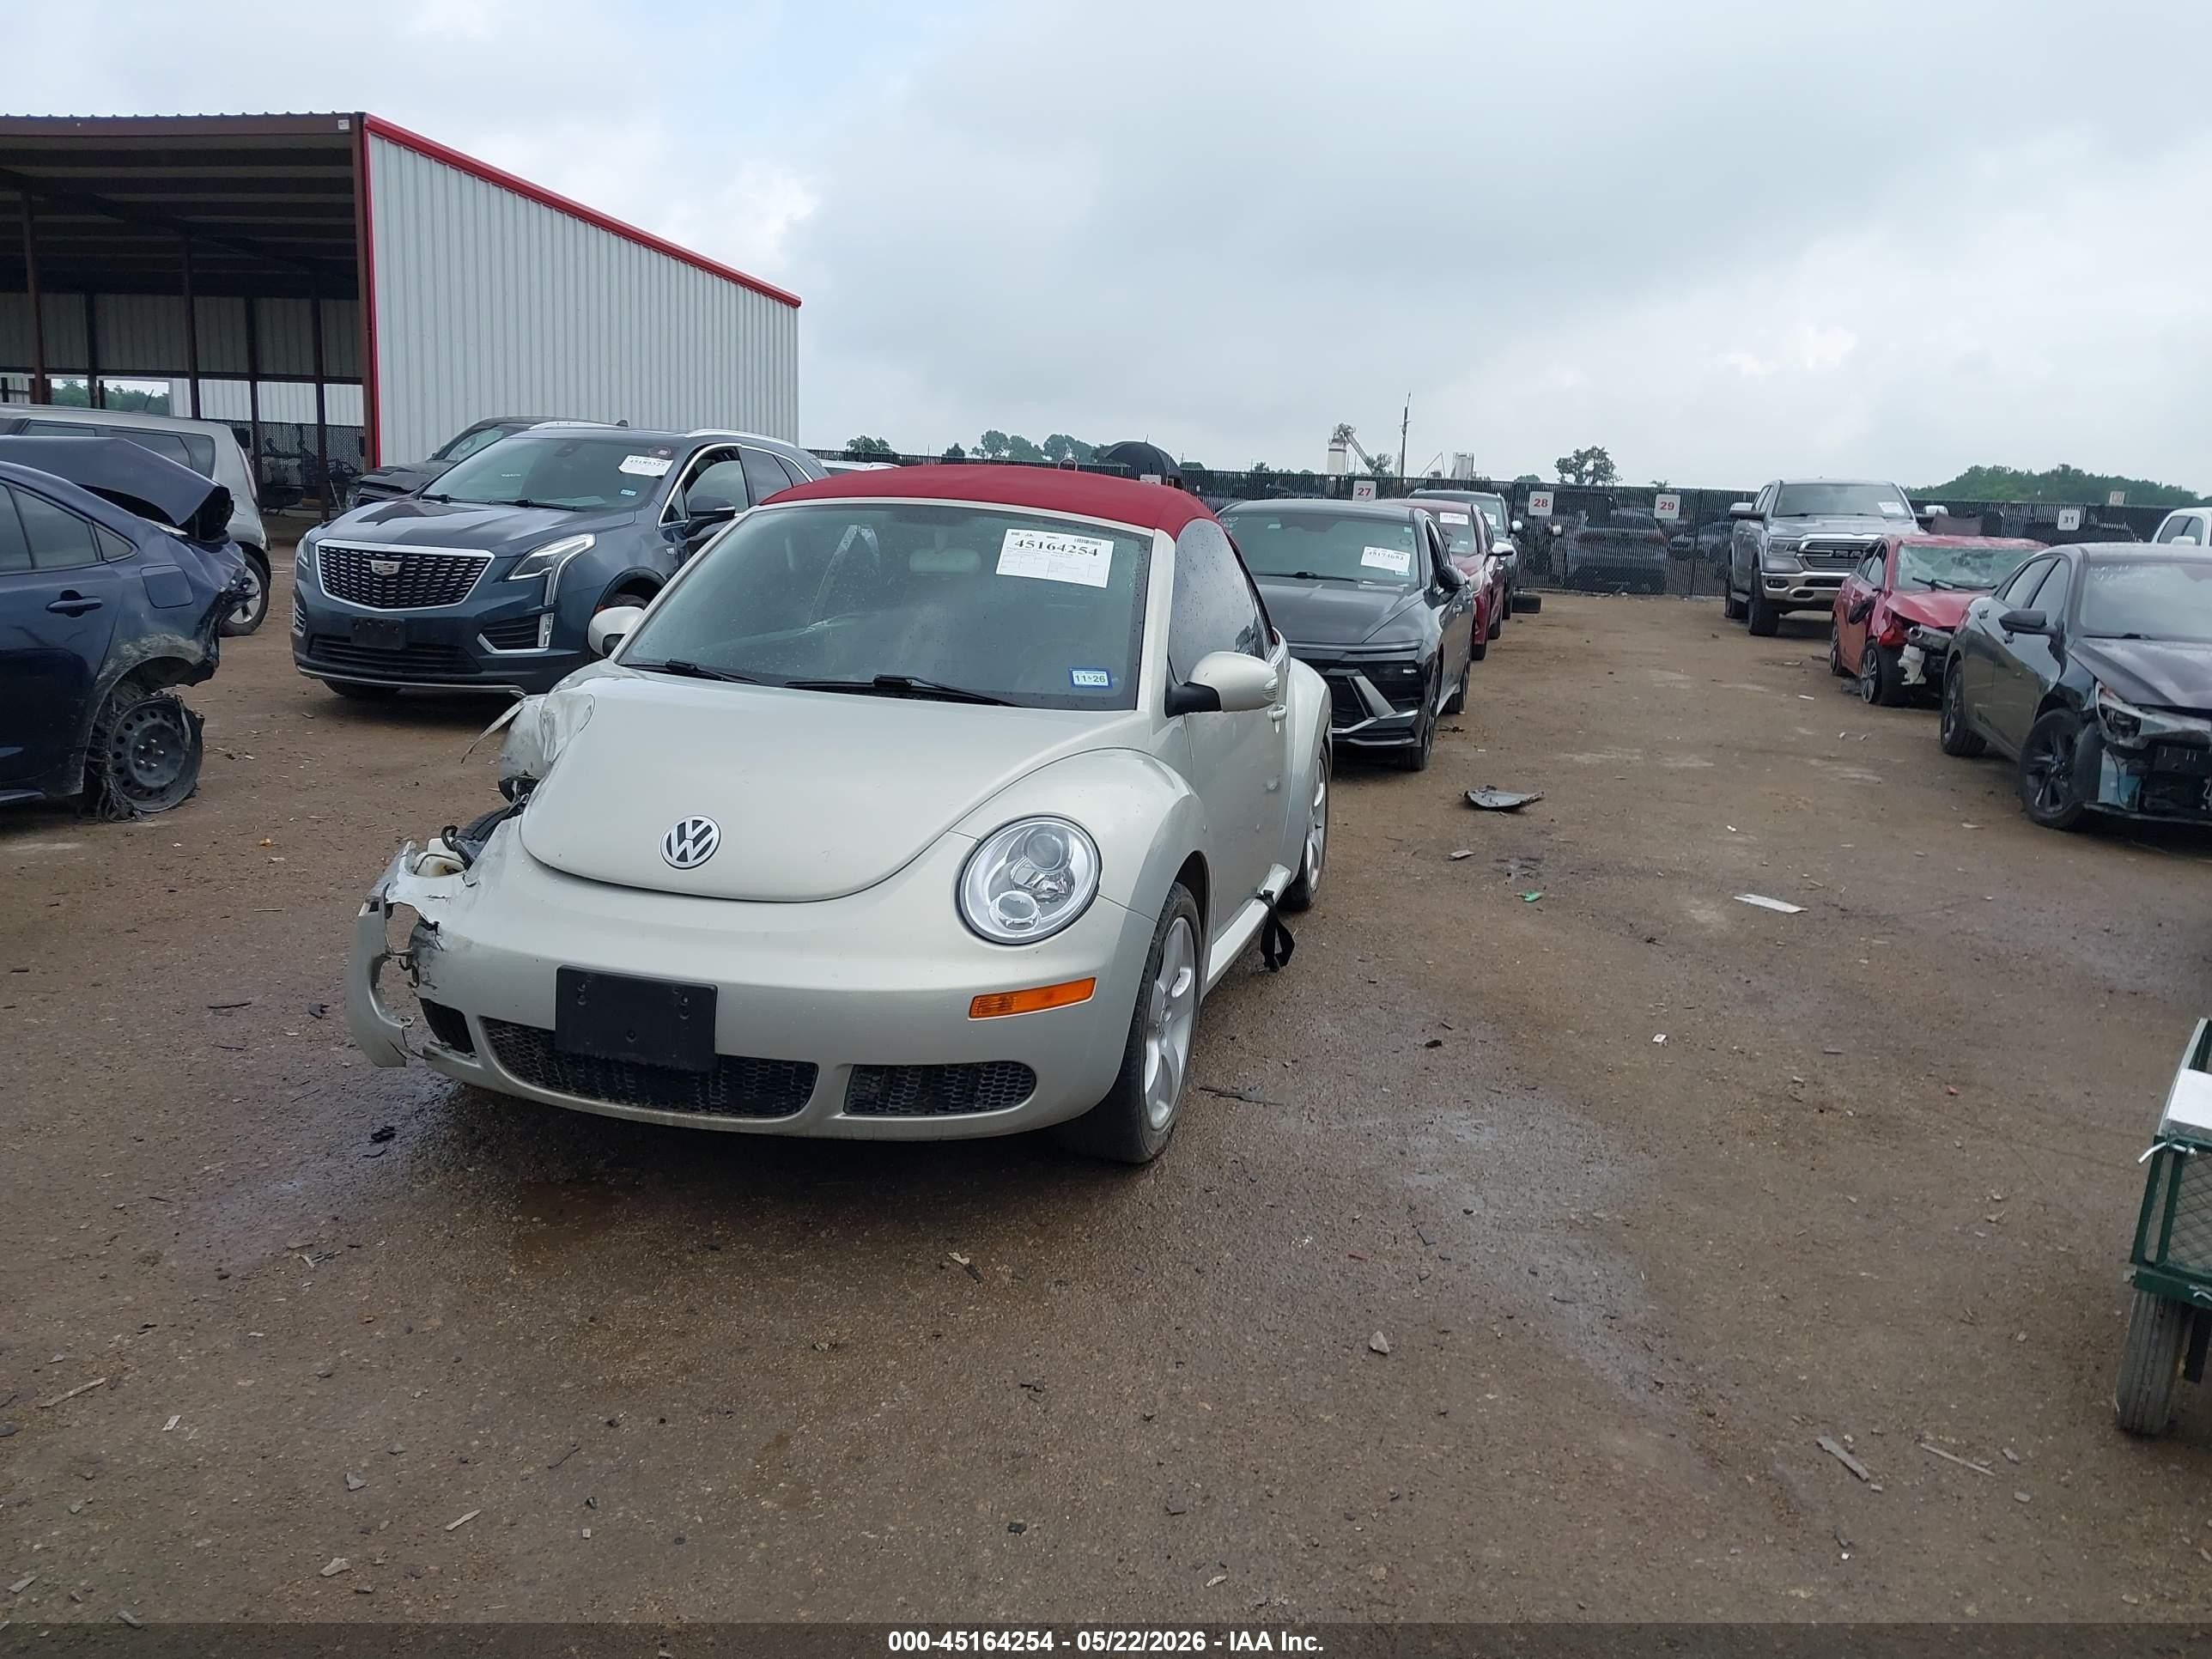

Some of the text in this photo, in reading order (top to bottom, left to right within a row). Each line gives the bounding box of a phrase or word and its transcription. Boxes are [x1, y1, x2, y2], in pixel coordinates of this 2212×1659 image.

[1358, 487, 1371, 496] 27
[1534, 498, 1548, 507] 28
[1660, 501, 1675, 511] 29
[2063, 515, 2075, 524] 31
[1014, 539, 1098, 556] 45164254
